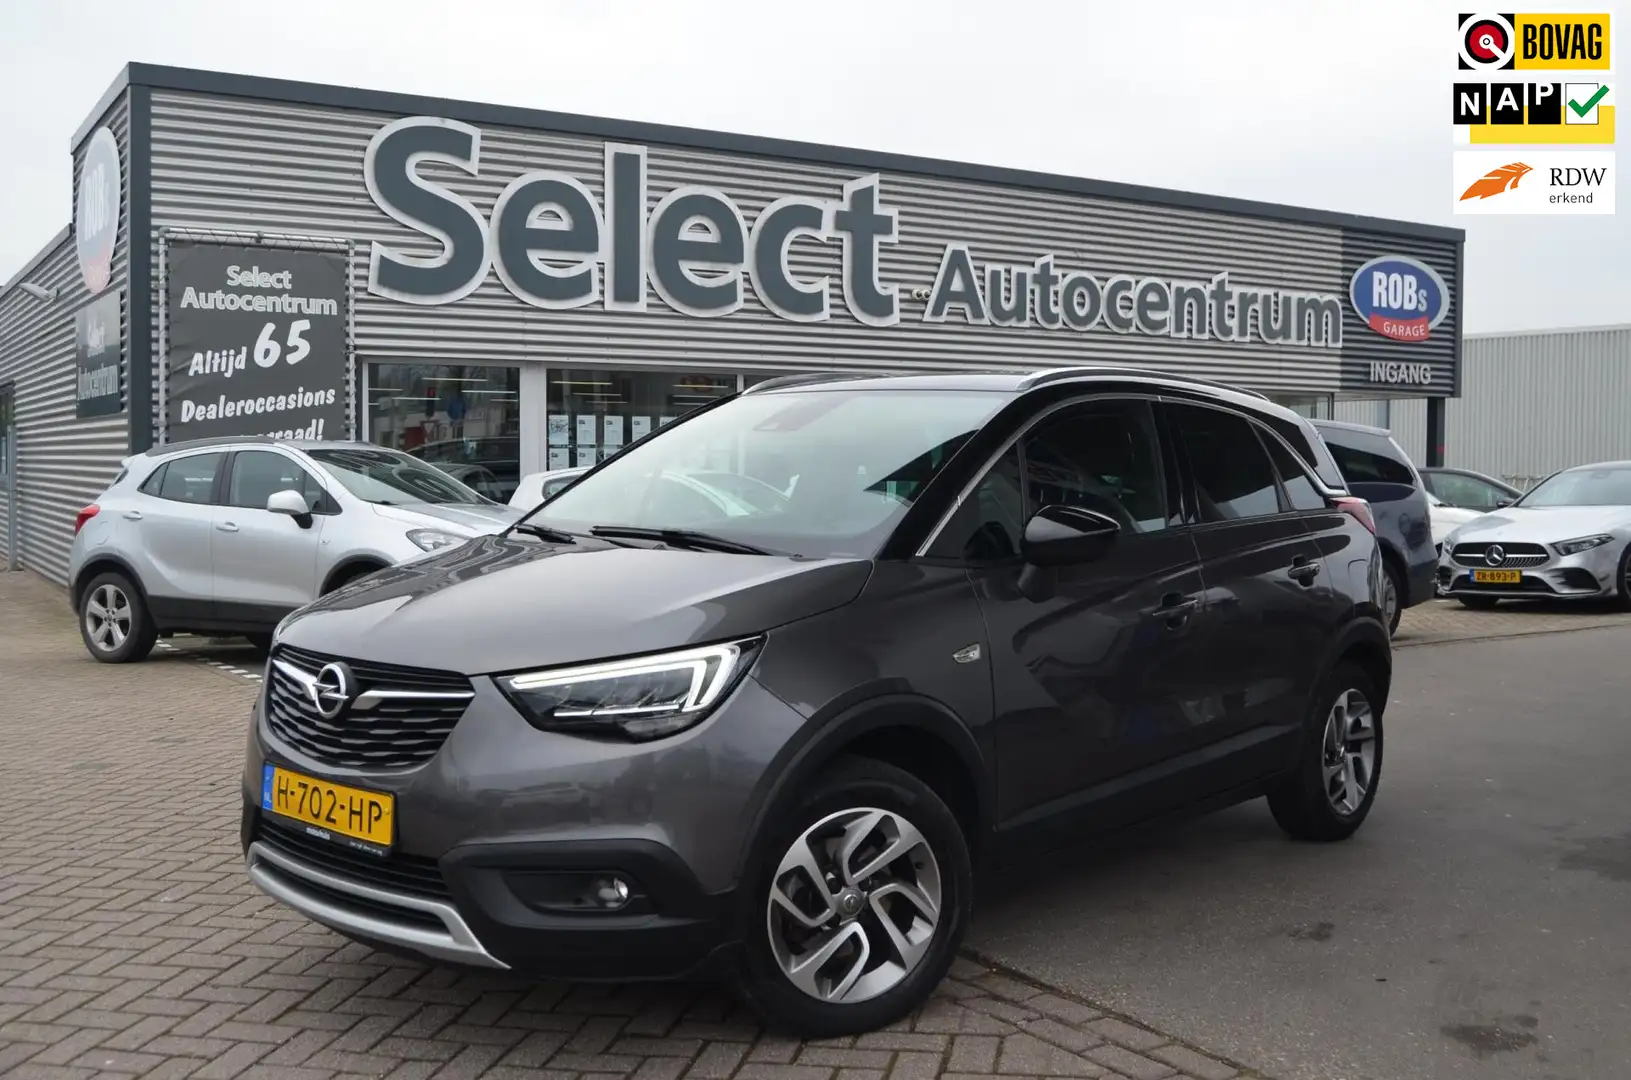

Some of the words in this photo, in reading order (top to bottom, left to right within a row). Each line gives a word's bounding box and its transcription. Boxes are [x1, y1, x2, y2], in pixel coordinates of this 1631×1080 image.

[364, 116, 900, 327] Select
[922, 242, 1343, 348] Autocentrum
[226, 265, 293, 289] Select
[1372, 271, 1428, 312] ROBs
[180, 286, 338, 316] Autocentrum
[1383, 321, 1425, 337] GARAGE
[188, 346, 248, 378] Altijd
[253, 319, 311, 368] 65
[1369, 360, 1432, 384] INGANG
[181, 386, 336, 423] Dealeroccasions
[277, 775, 382, 834] H-702-HP
